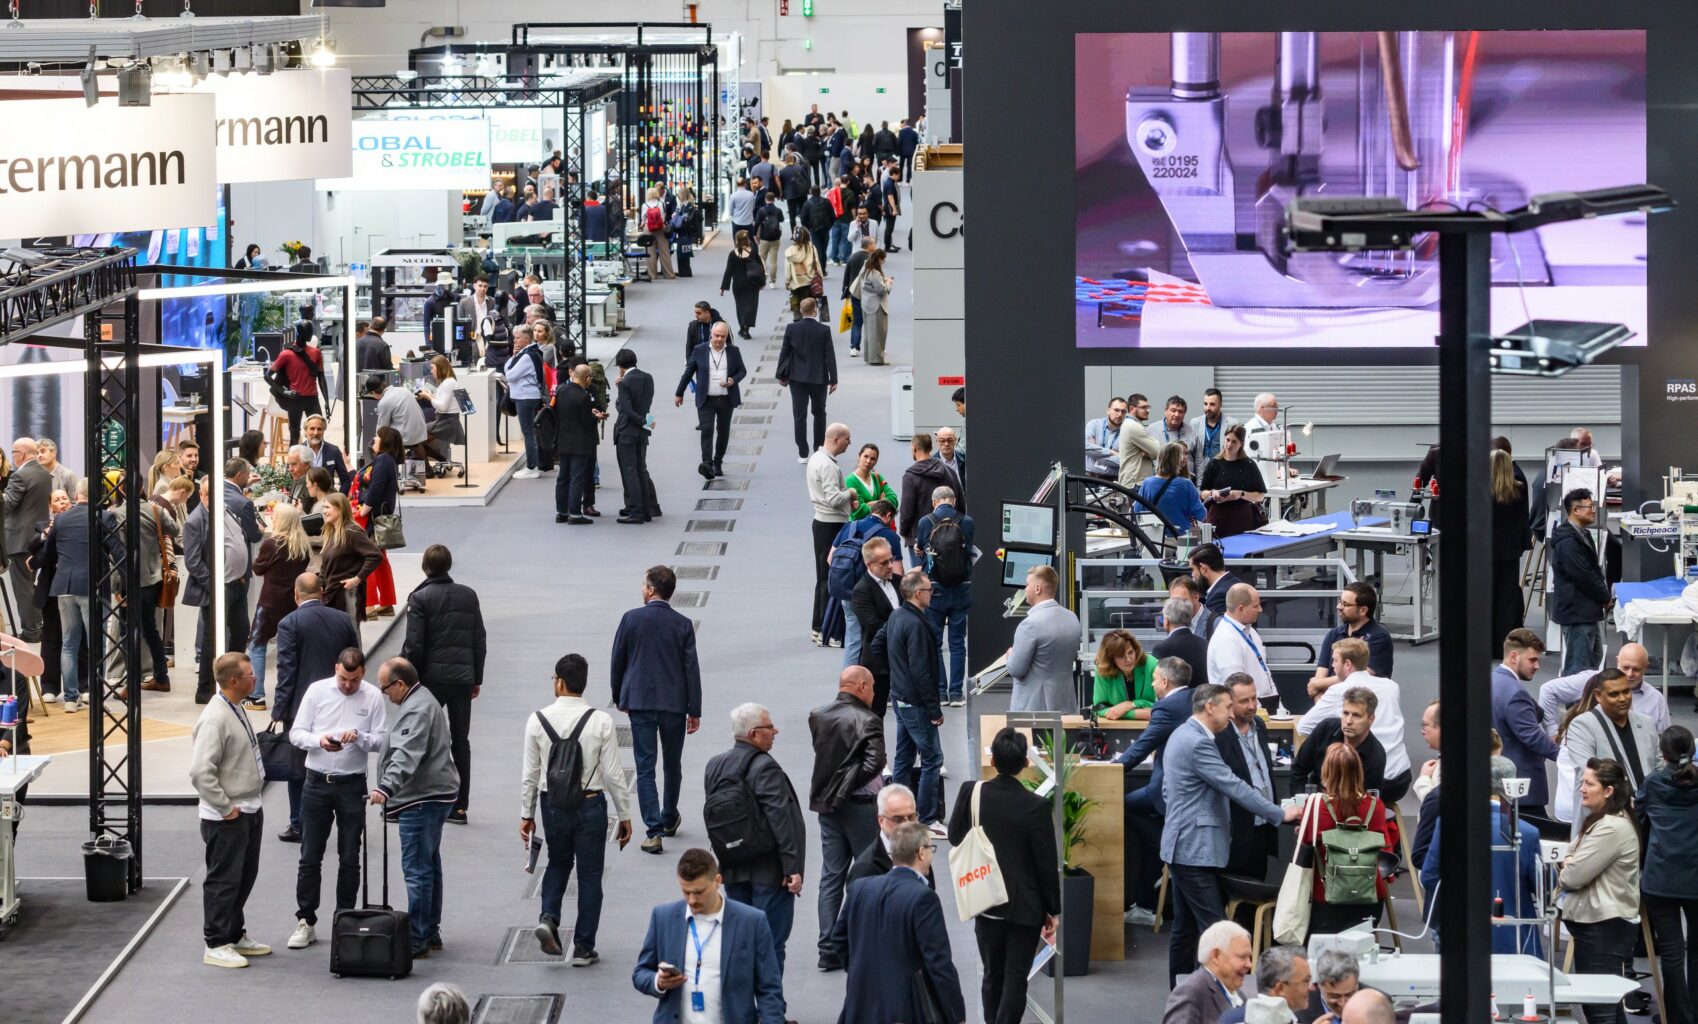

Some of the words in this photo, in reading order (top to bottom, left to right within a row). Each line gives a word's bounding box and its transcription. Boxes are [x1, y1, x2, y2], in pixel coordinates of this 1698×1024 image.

[381, 153, 394, 167] &
[398, 152, 486, 167] STROBEL
[1168, 155, 1199, 166] 0195
[1153, 167, 1198, 178] 220024
[1666, 383, 1697, 393] RPAS
[1633, 527, 1678, 535] Richpeace
[1518, 783, 1525, 795] 6
[1550, 847, 1559, 860] 5
